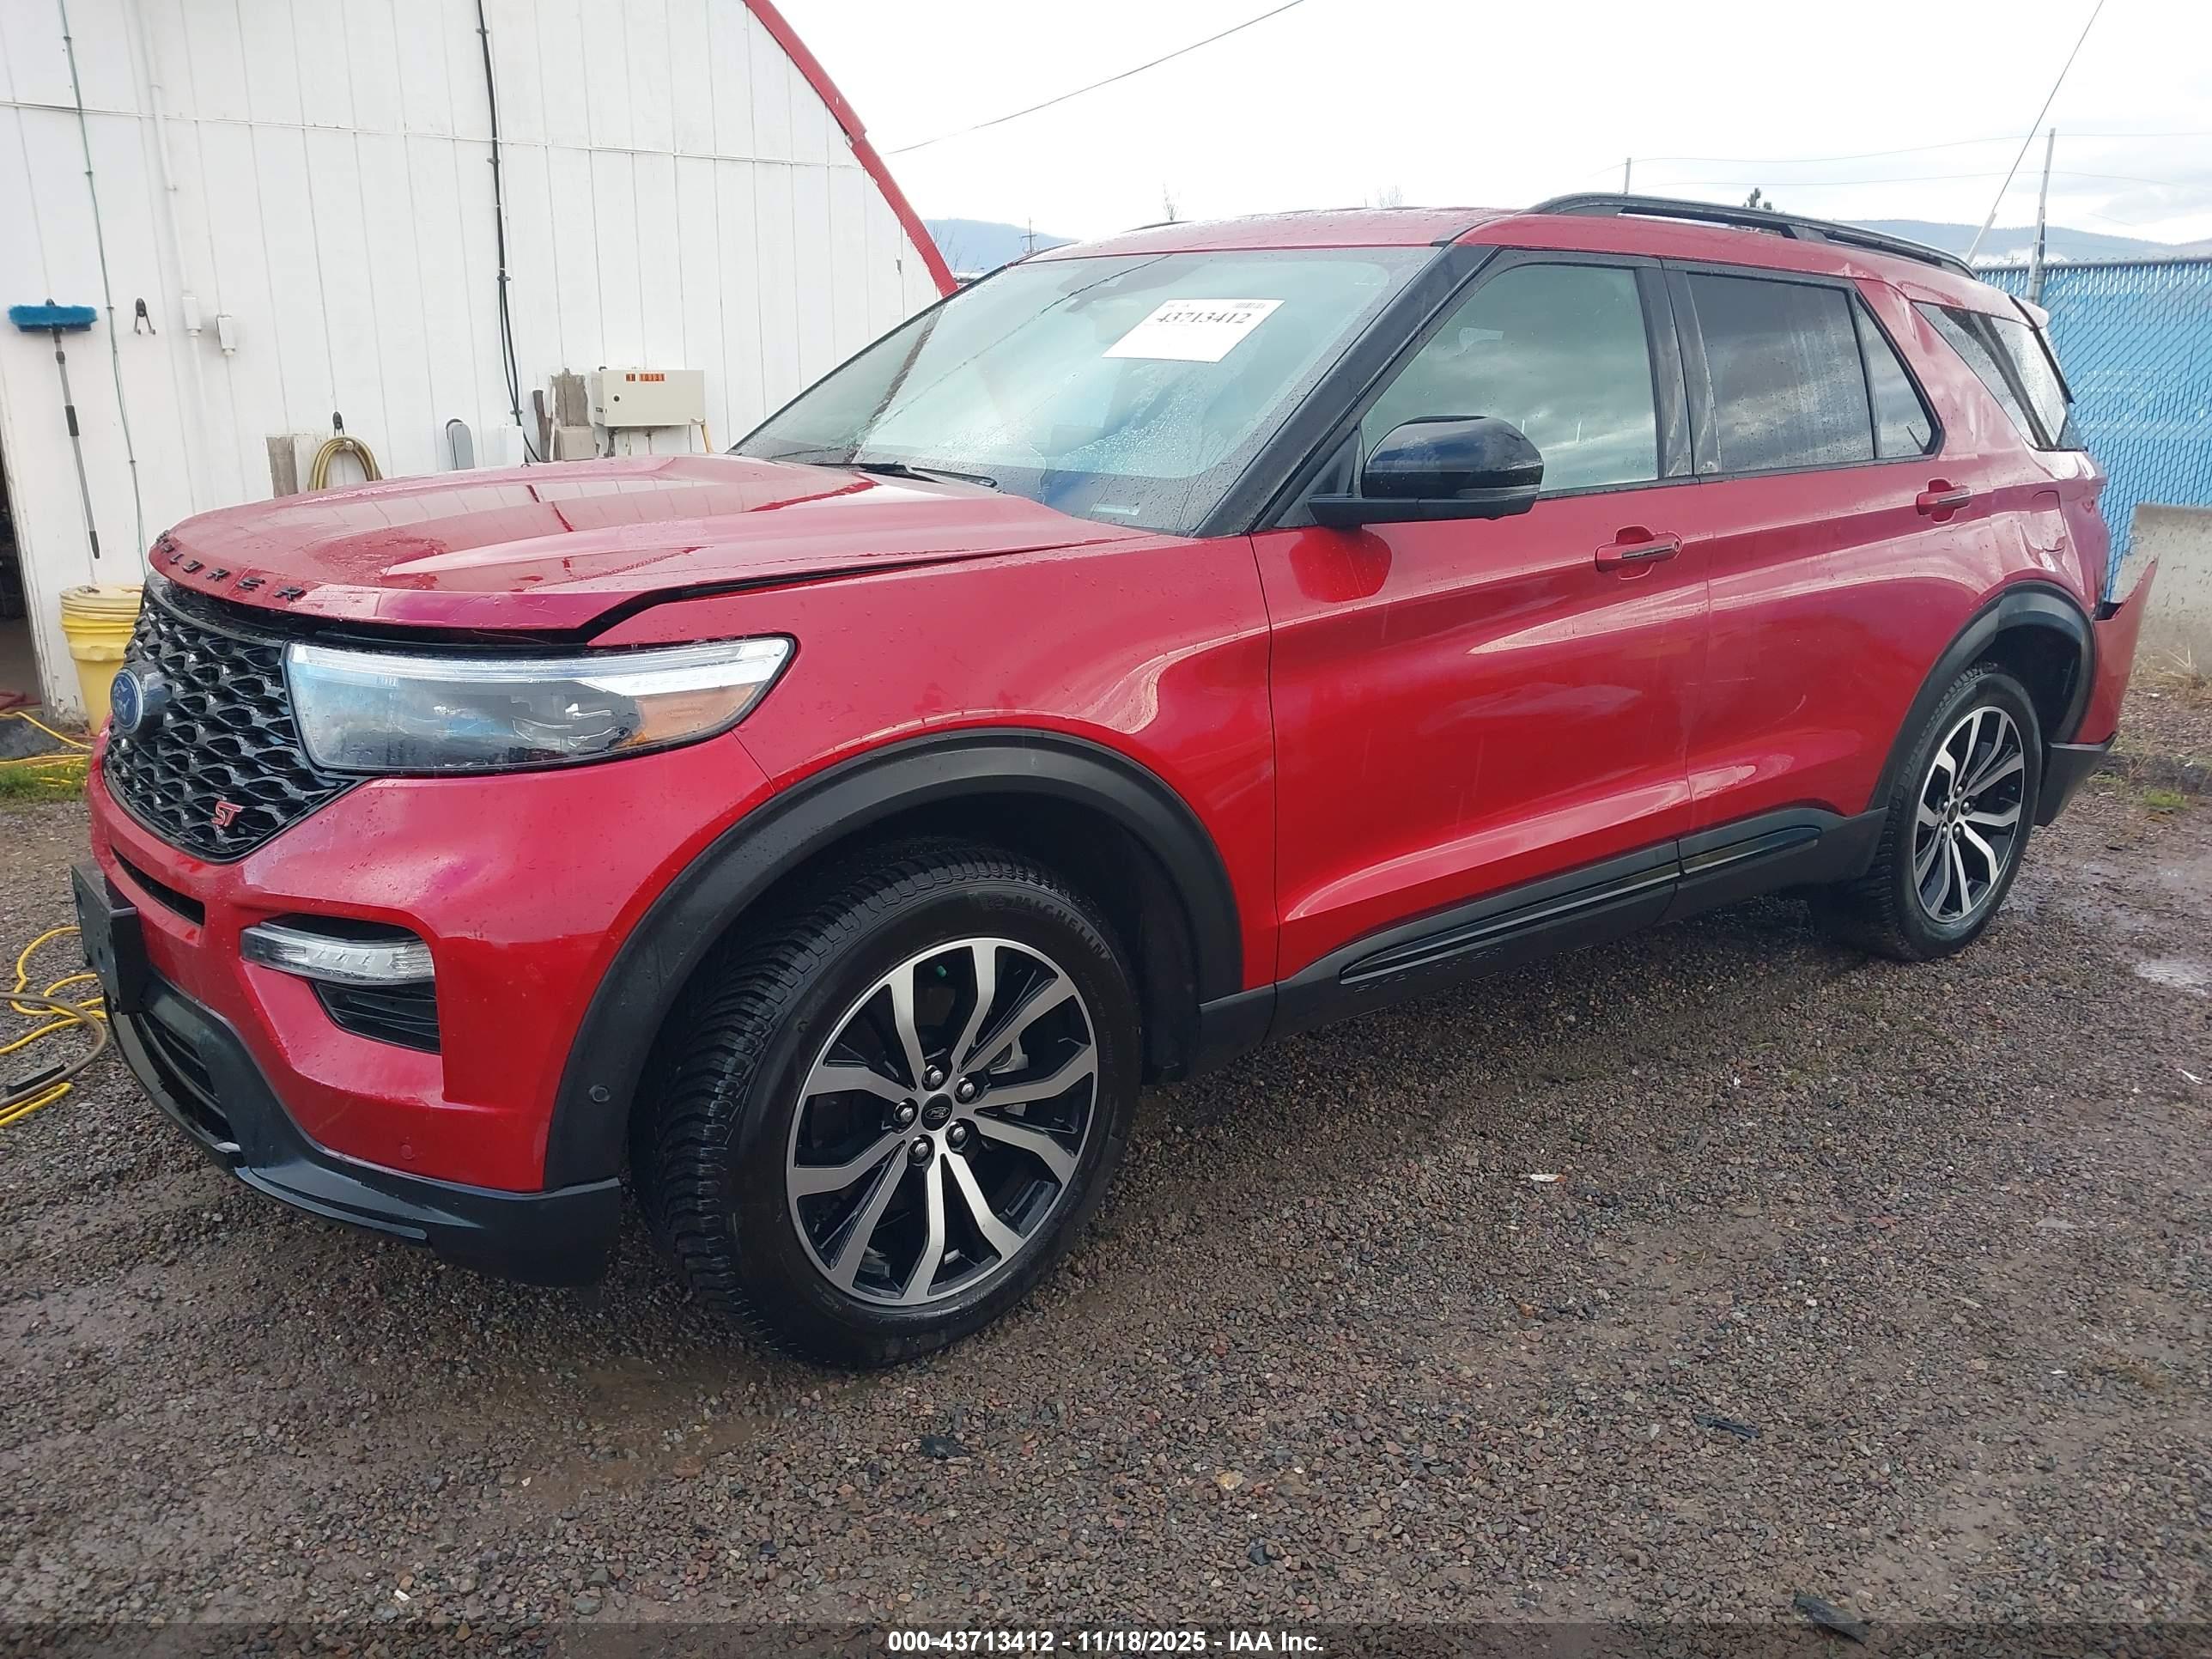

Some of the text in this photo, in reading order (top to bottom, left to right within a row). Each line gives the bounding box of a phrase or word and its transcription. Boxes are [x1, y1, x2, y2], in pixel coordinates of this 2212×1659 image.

[1156, 312, 1253, 324] 43713412
[155, 529, 307, 602] PLORER
[210, 800, 243, 827] ST
[1013, 895, 1113, 962] MICHELIN
